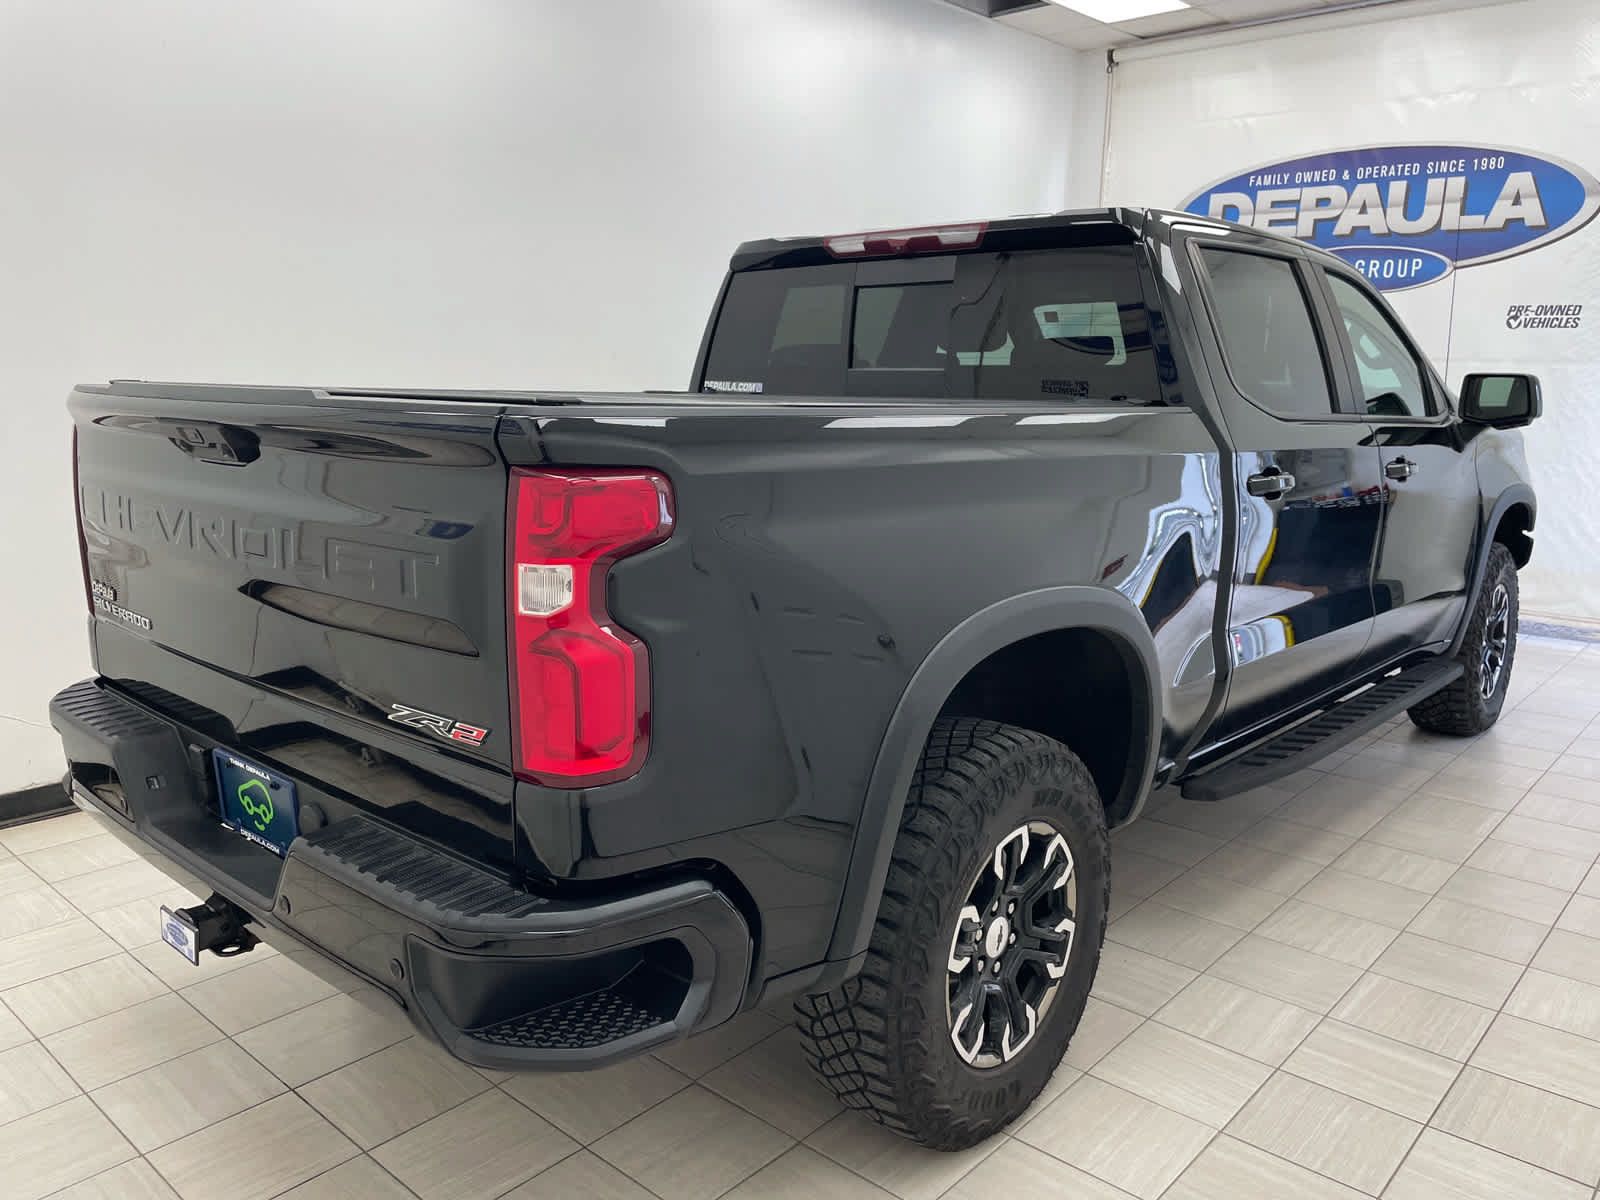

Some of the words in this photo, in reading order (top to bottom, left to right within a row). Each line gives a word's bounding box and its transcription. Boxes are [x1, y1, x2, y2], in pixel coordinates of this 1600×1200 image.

[1249, 173, 1290, 187] FAMILY
[1295, 169, 1337, 184] OWNED
[1342, 169, 1351, 180] &
[1356, 163, 1420, 180] OPERATED
[1426, 159, 1466, 174] SINCE
[1472, 156, 1505, 171] 1980
[1207, 171, 1548, 238] DEPAULA
[1506, 304, 1583, 317] PRE-OWNED
[1522, 316, 1581, 329] VEHICLES
[81, 486, 441, 600] CHEVROLET
[93, 596, 151, 631] SILVERADO
[387, 703, 489, 748] ZR2
